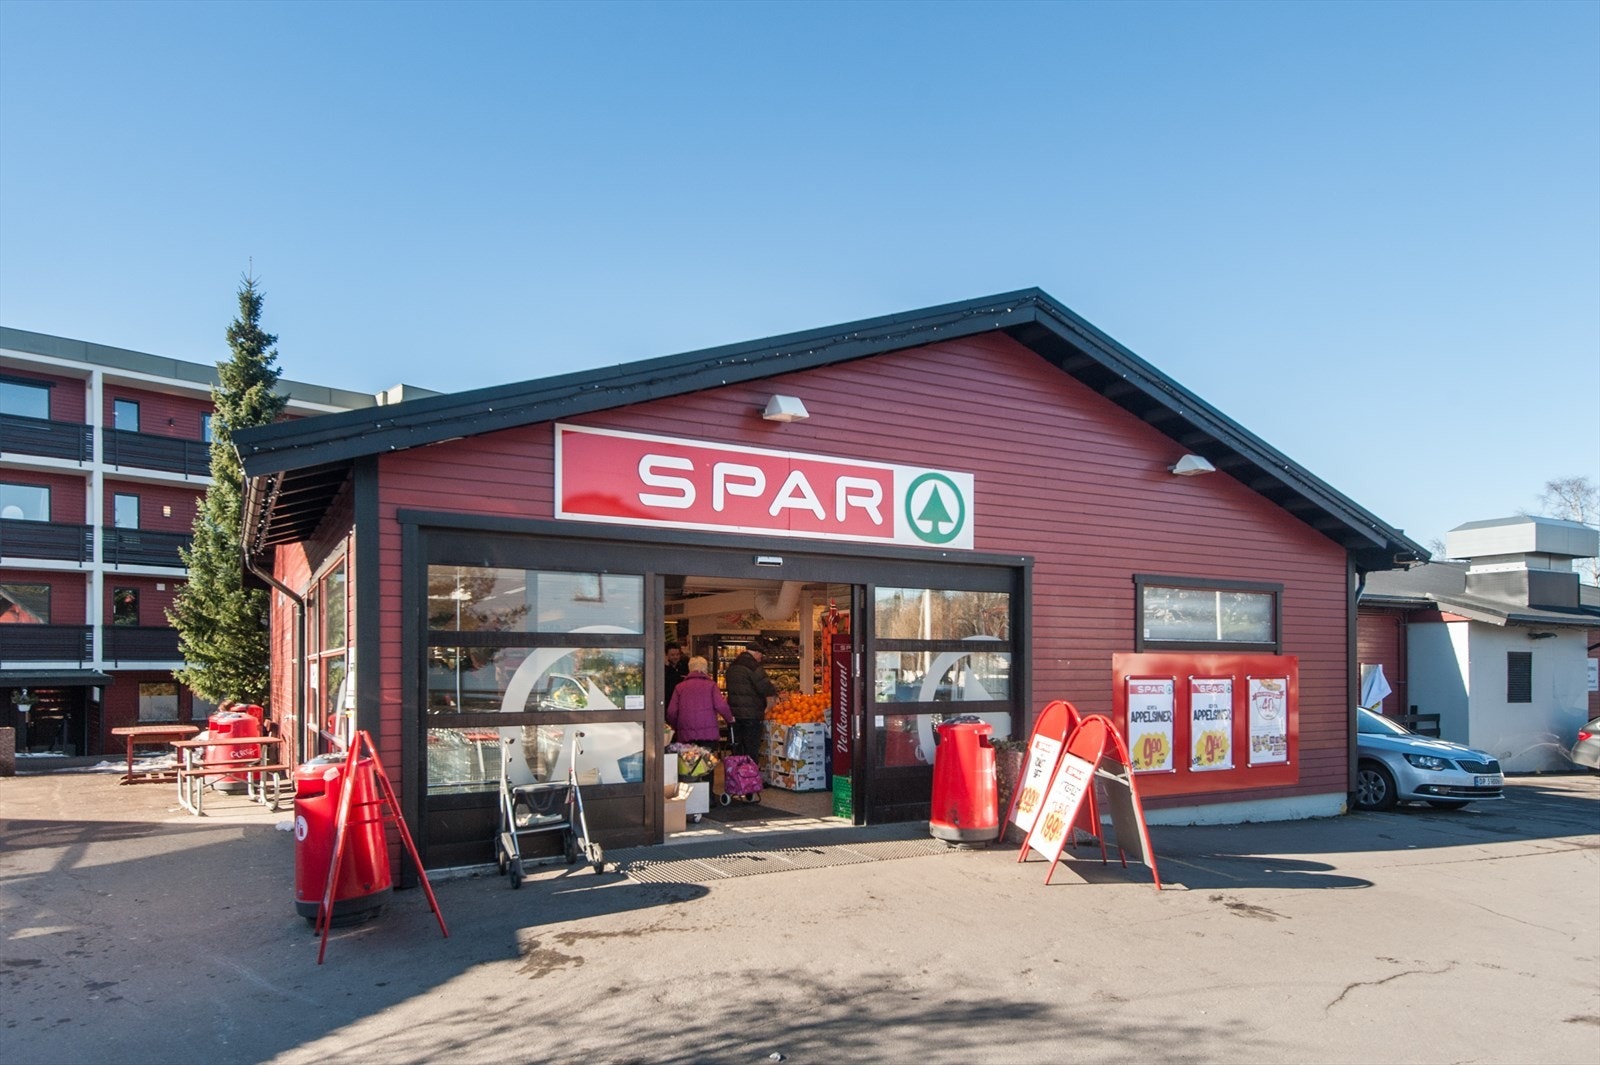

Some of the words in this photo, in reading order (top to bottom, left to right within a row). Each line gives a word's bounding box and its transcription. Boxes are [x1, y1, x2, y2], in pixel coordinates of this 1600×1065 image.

[638, 453, 883, 525] SPAR
[1137, 685, 1164, 694] SPAR
[1199, 684, 1225, 693] SPAR
[836, 661, 848, 753] Velkommen!
[1130, 710, 1172, 723] APPELSINER
